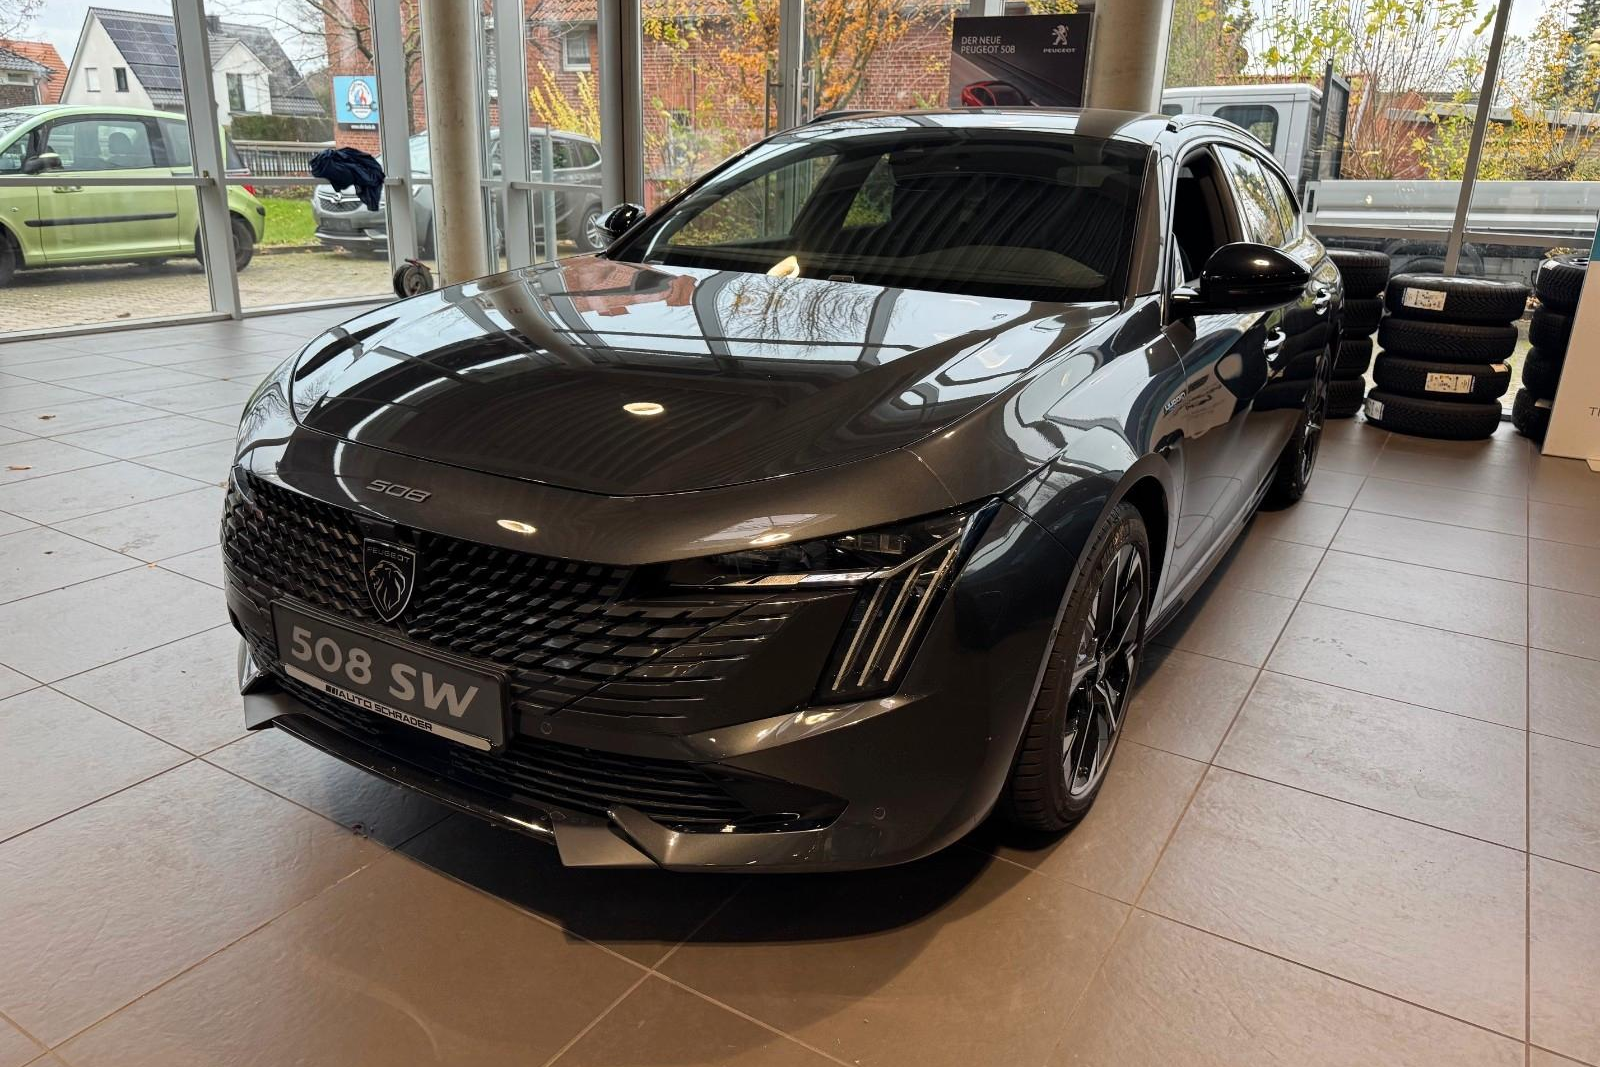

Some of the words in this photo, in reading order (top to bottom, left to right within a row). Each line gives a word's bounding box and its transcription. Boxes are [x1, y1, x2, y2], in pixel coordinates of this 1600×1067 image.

[961, 36, 977, 45] DER
[979, 36, 1001, 45] NEUE
[961, 45, 999, 54] PEUGEOT
[1001, 45, 1016, 54] 508
[366, 479, 432, 503] 508
[367, 546, 411, 563] PEUGEOT
[291, 625, 372, 685] 508
[388, 663, 479, 718] SW
[338, 691, 373, 709] AUTO
[374, 703, 433, 732] SCHRADER
